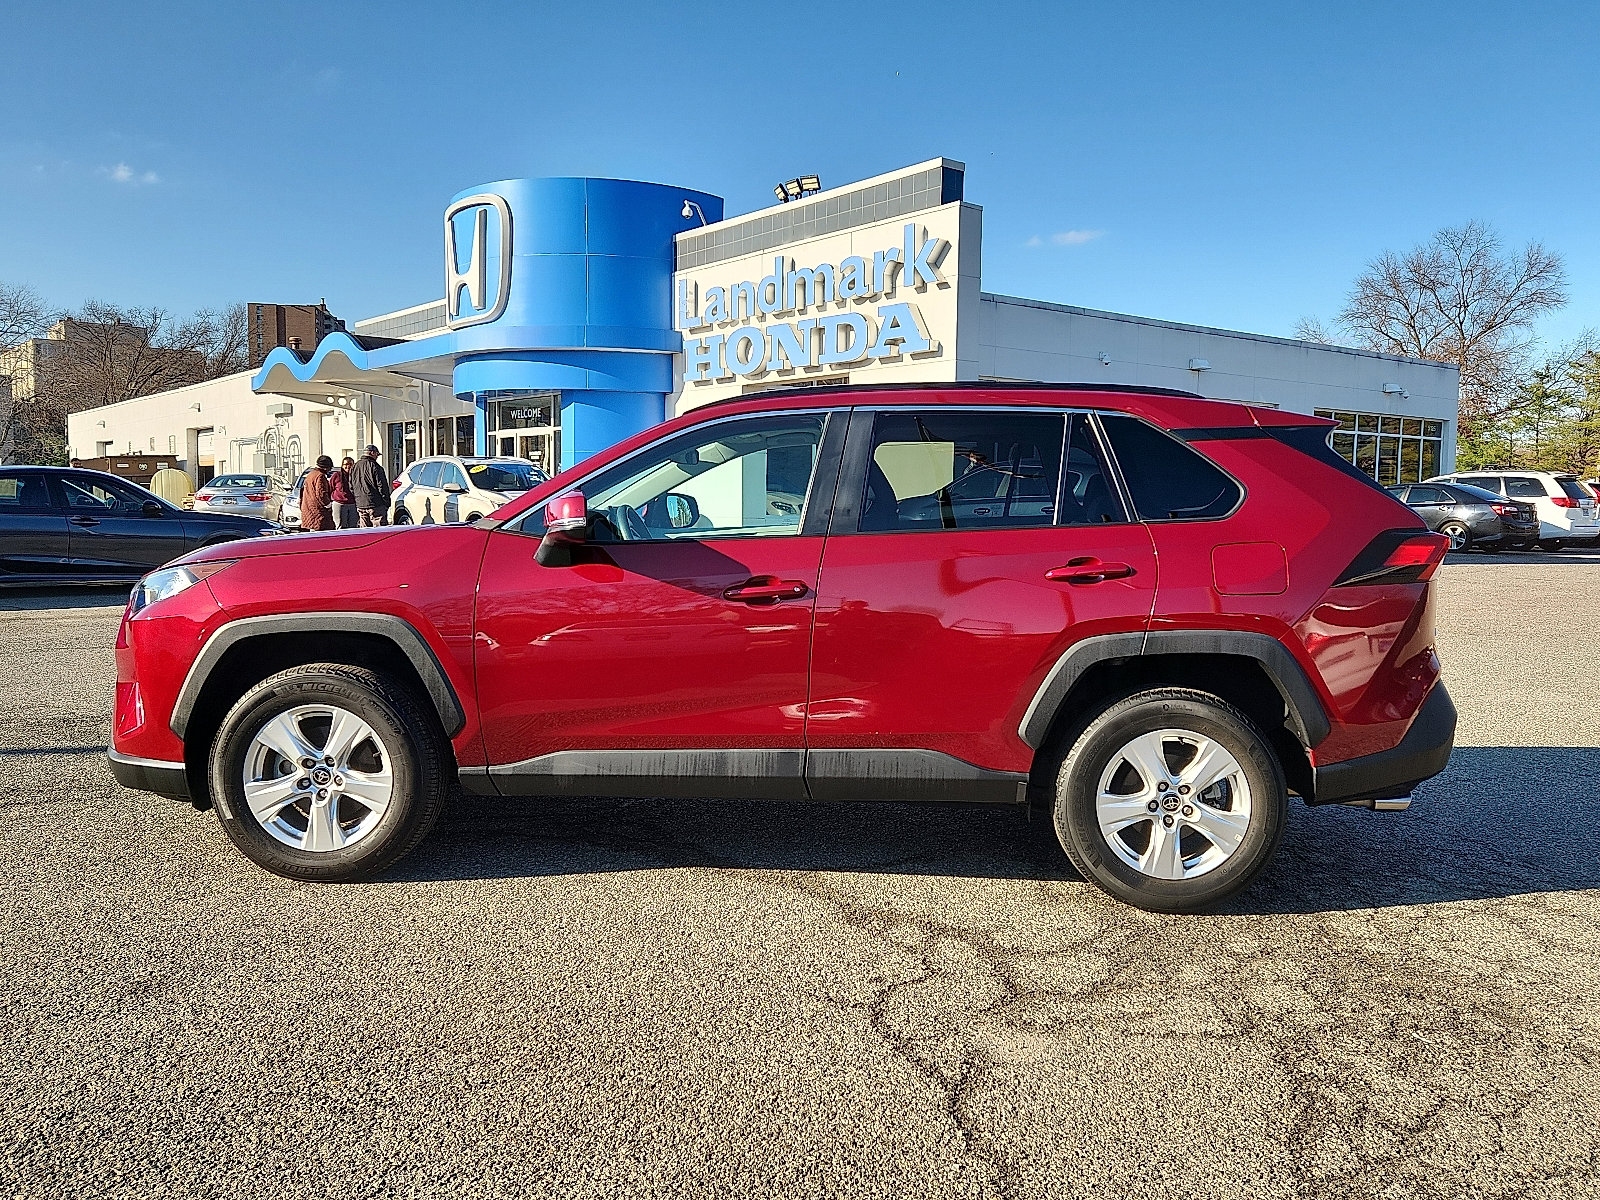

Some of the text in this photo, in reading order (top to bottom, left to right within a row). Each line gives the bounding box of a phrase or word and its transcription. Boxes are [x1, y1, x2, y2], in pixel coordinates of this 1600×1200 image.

[678, 223, 948, 333] Landmark
[683, 302, 940, 384] HONDA
[510, 407, 542, 419] WELCOME
[302, 683, 361, 700] MICHELIN
